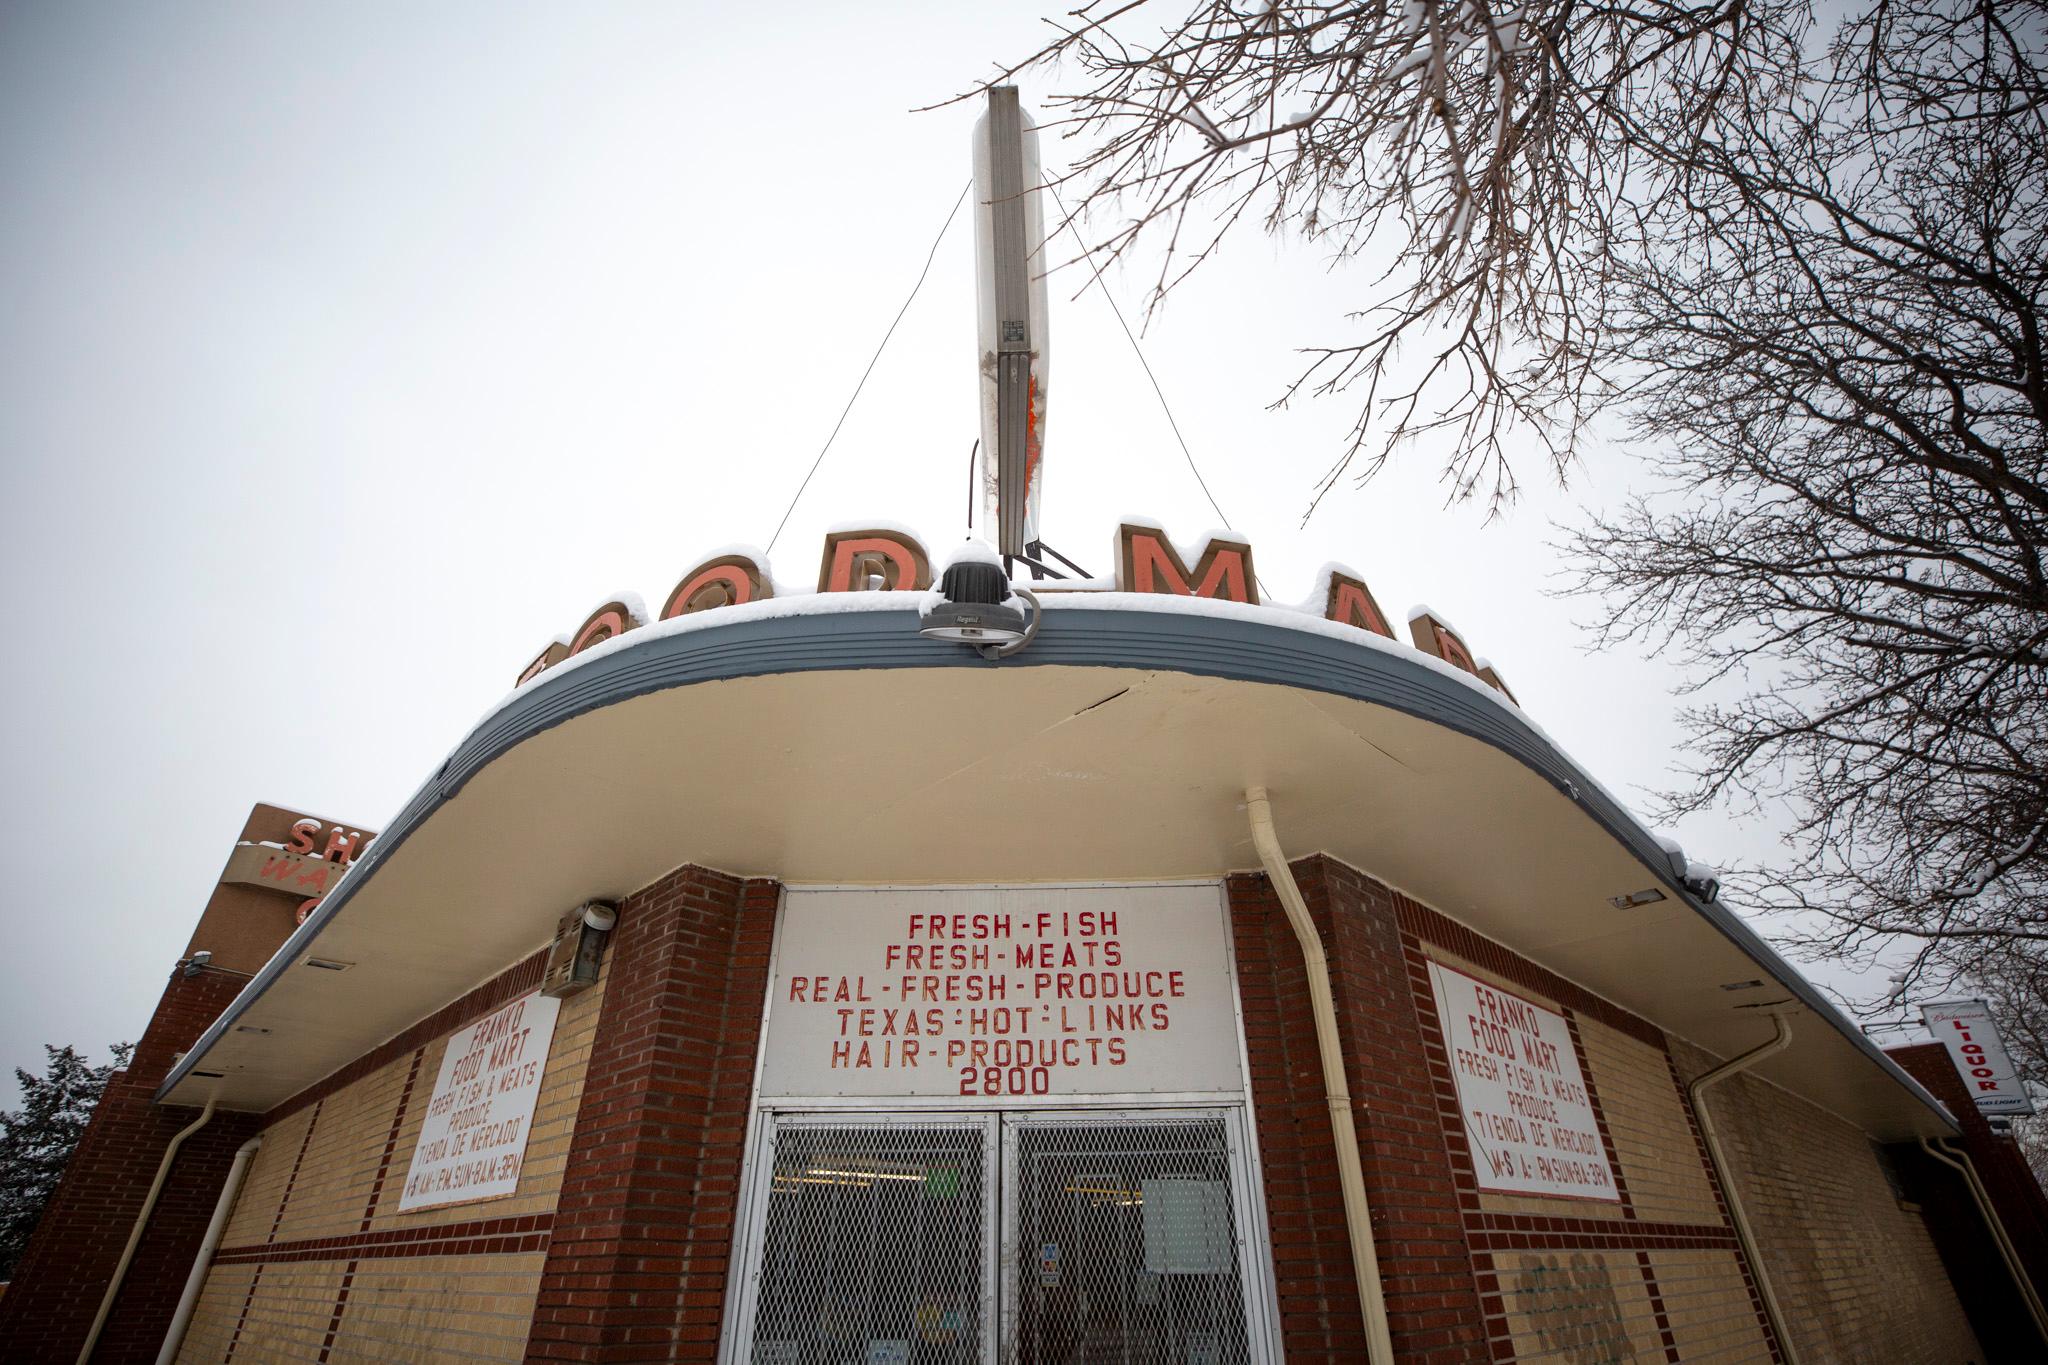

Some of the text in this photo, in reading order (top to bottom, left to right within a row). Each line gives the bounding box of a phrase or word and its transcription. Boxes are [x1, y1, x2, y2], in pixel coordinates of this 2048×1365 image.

[469, 1000, 526, 1053] FRANKO
[1474, 985, 1540, 1038] FRANKO
[449, 1028, 531, 1089] FOOD MART
[1468, 1014, 1561, 1075] FOOD MART
[1953, 1020, 2000, 1091] LIQUOR
[429, 1090, 456, 1120] FRESH
[457, 1079, 485, 1109] FISH
[498, 1061, 538, 1094] MEATS
[959, 1066, 1049, 1096] 2800
[1457, 1048, 1586, 1107] FRESH FISH & MEATS
[447, 1100, 493, 1134] PRODUCE
[1507, 1090, 1559, 1124] PRODUCE
[451, 1132, 468, 1158] DE
[1530, 1121, 1548, 1148] DE
